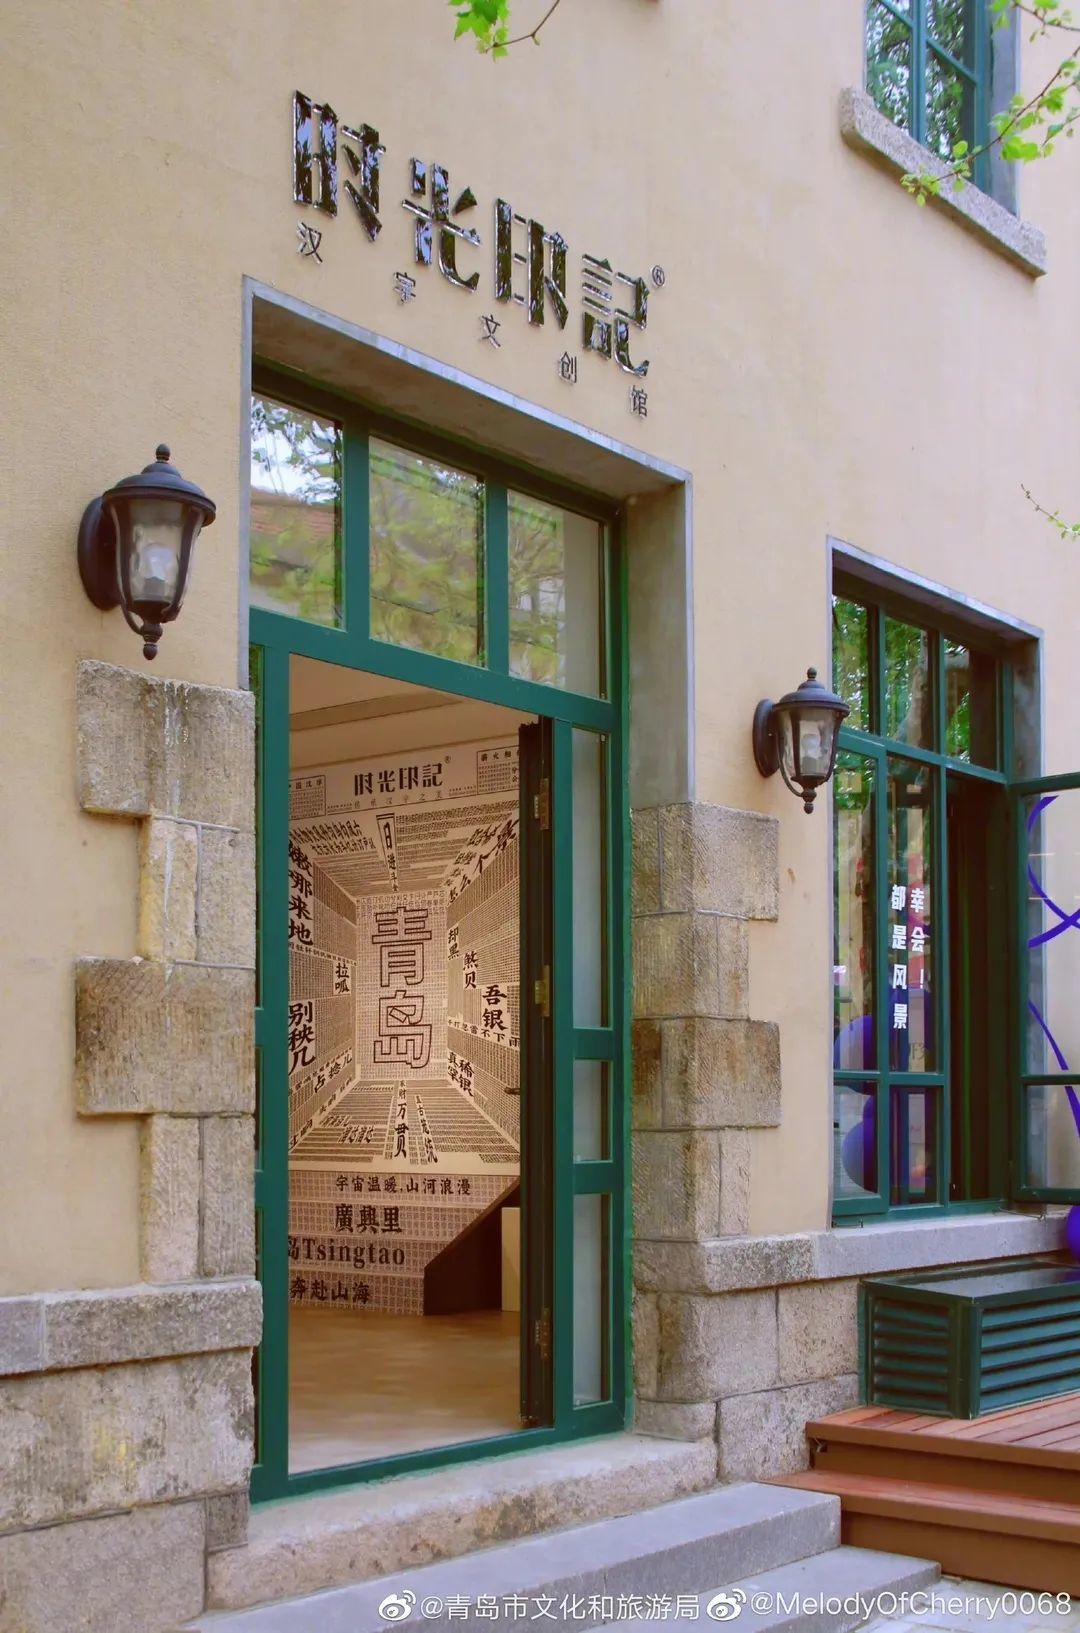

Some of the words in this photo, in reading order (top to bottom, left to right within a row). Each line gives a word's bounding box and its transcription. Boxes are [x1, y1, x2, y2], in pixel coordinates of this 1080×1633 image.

[296, 221, 649, 419] 汉字文创馆
[371, 906, 433, 1070] 青岛
[482, 984, 509, 1032] 吾银
[891, 884, 908, 1029] 都是风景
